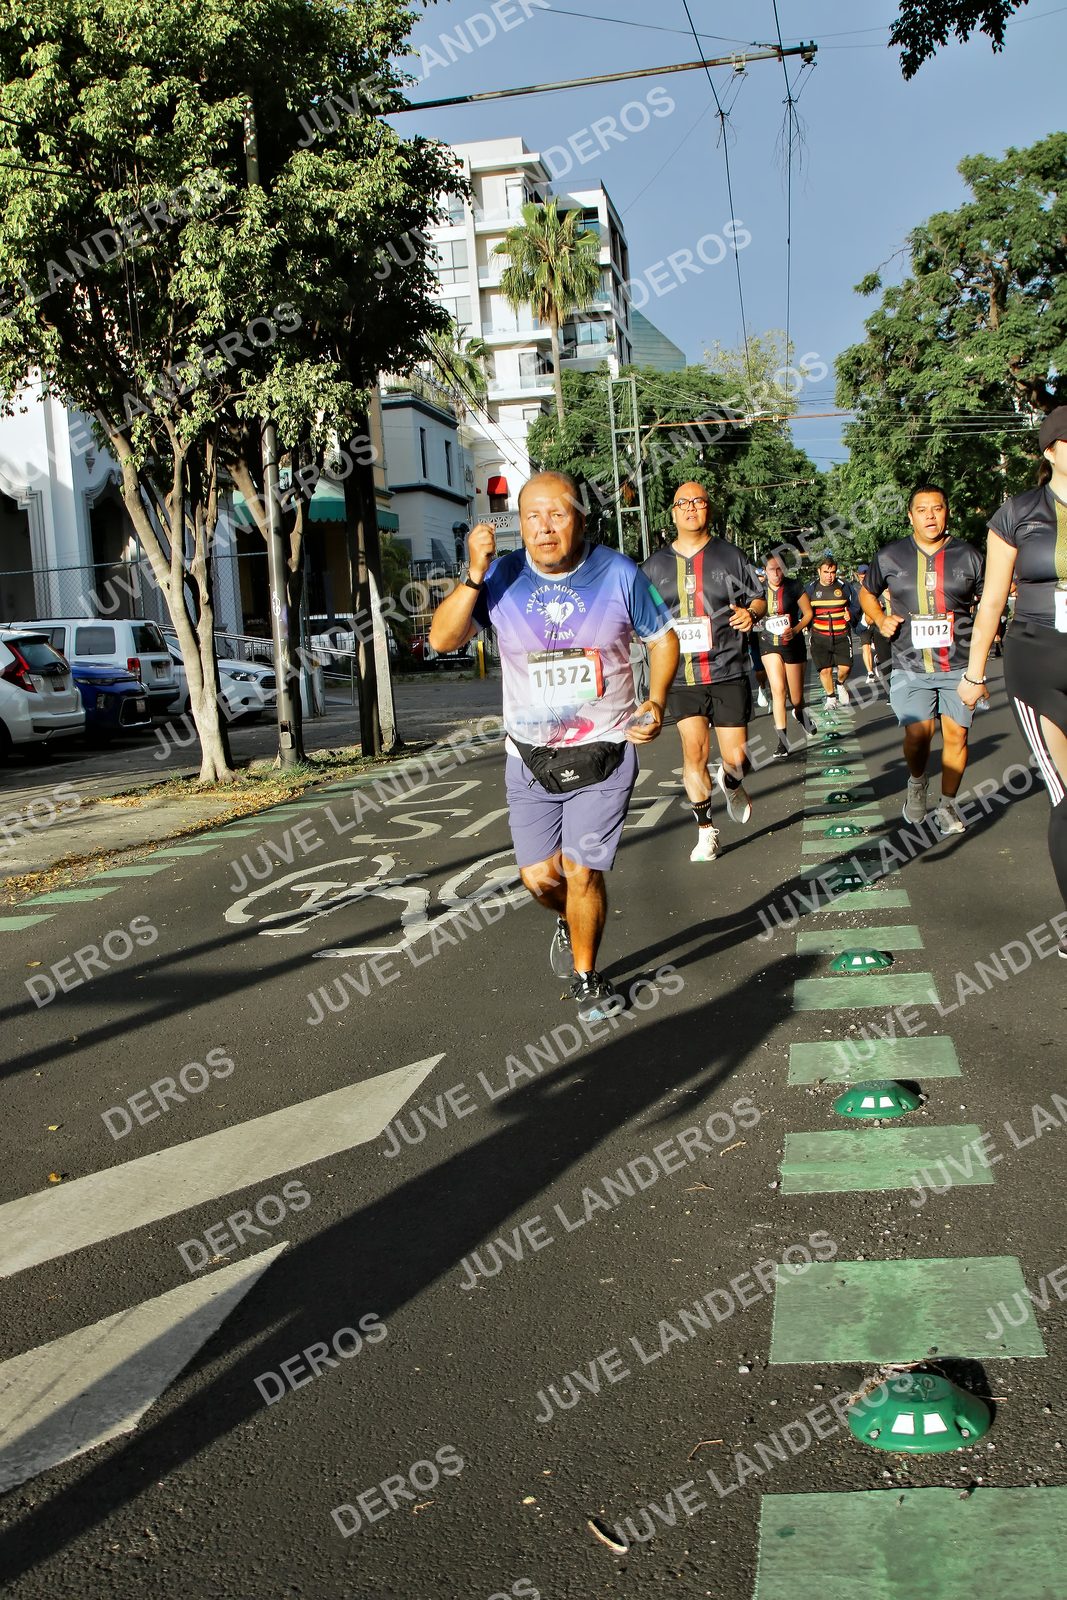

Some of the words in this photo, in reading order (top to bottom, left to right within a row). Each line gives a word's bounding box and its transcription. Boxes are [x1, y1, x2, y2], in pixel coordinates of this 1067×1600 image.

[526, 584, 550, 614] TALPITA
[553, 583, 586, 613] MORELOS
[544, 629, 575, 640] TEAM
[914, 624, 948, 636] 11012
[533, 664, 591, 688] 11372
[561, 774, 580, 783] adidas
